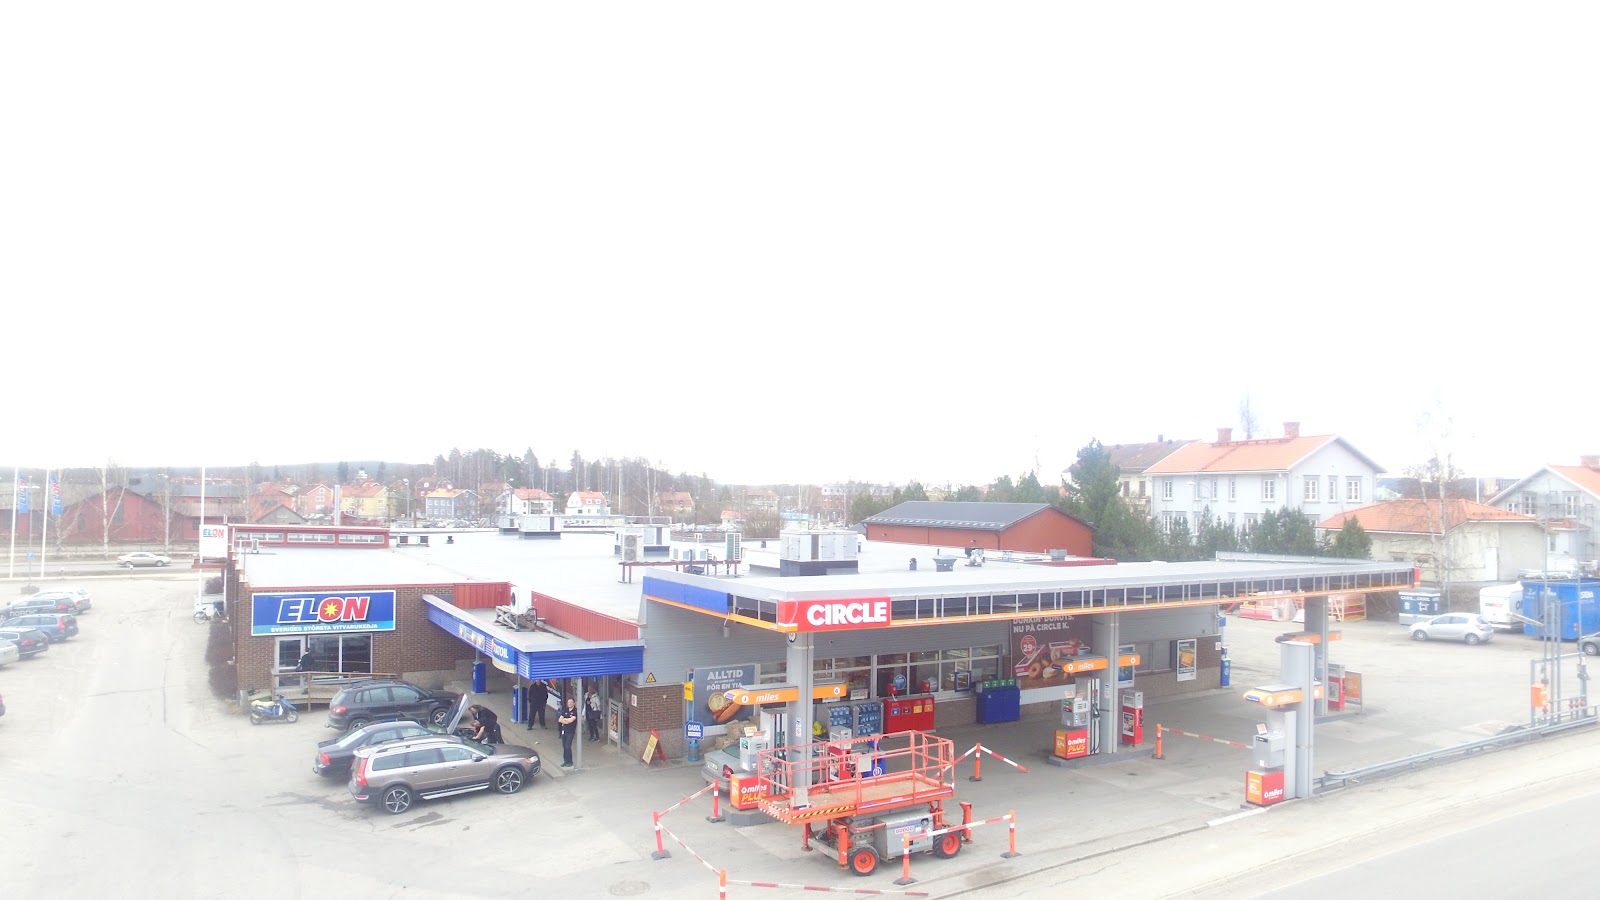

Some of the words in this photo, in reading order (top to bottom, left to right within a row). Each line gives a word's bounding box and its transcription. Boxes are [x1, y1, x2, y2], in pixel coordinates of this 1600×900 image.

[203, 528, 225, 536] ELON
[276, 596, 371, 624] ELON
[806, 601, 888, 627] CIRCLE
[303, 624, 332, 632] STÖRSTA
[332, 623, 378, 632] VITVARUKEDJA
[1013, 625, 1024, 633] NU
[1026, 623, 1036, 632] PÅ
[1037, 622, 1061, 631] CIRCLE
[706, 669, 744, 681] ALLTID
[706, 683, 721, 691] FÖR
[755, 693, 779, 703] miles
[1070, 737, 1086, 746] miles
[1068, 744, 1086, 752] PLUS
[1268, 788, 1283, 797] miles
